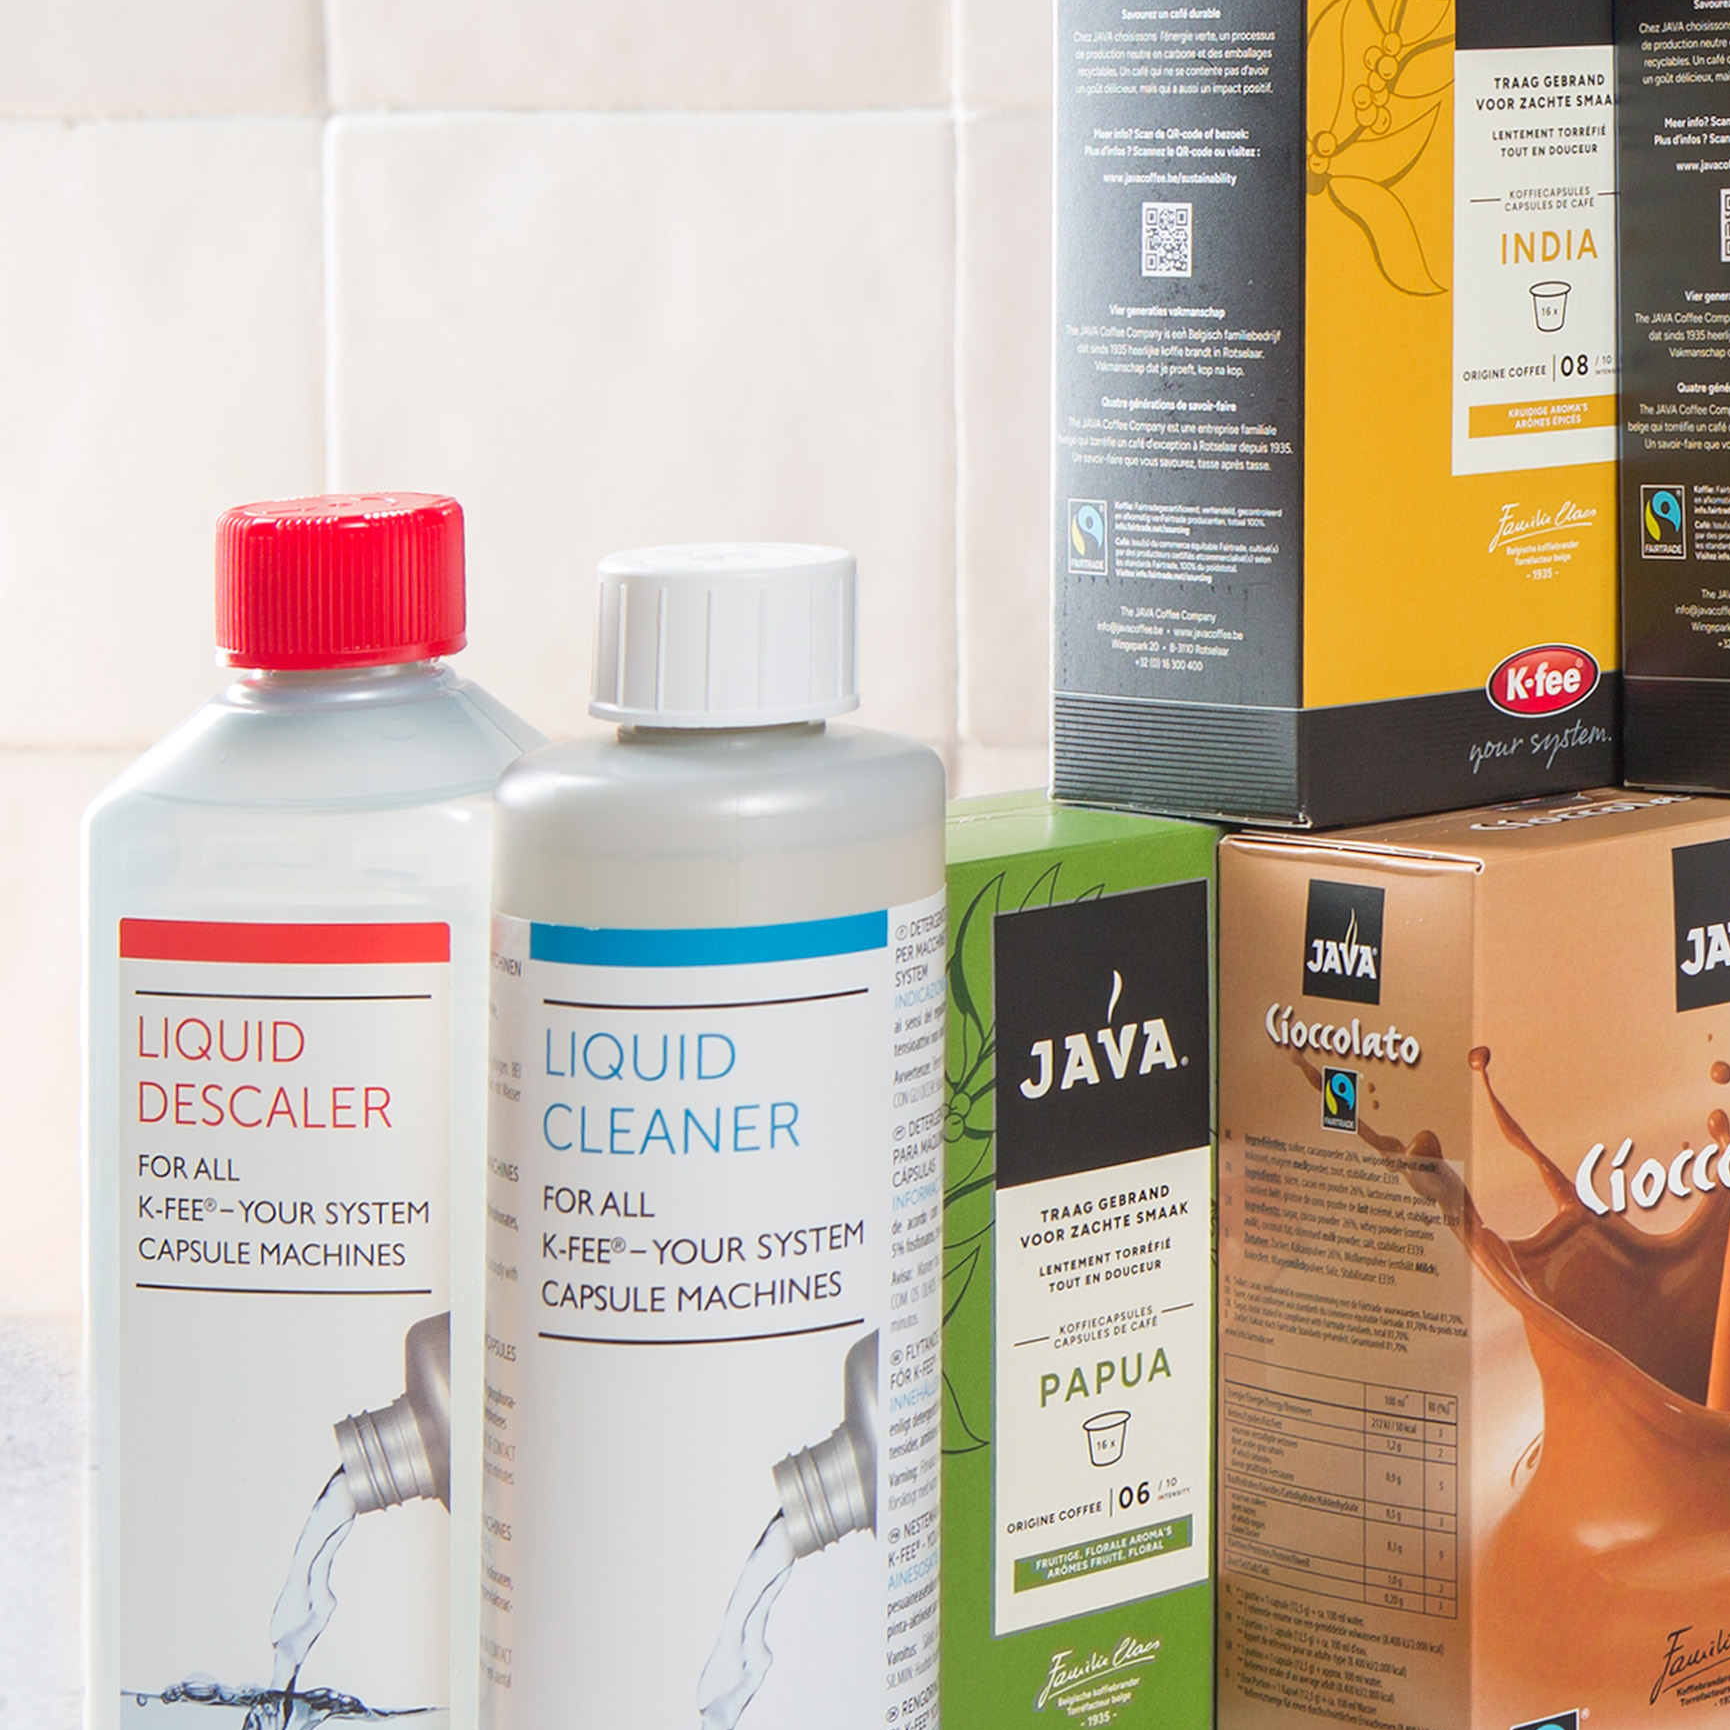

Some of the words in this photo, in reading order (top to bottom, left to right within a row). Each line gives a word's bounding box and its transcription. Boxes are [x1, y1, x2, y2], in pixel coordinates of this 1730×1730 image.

[1502, 229, 1597, 264] INDIA
[1463, 368, 1502, 381] ORIGINE
[1509, 365, 1546, 377] COFFEE
[1561, 354, 1588, 377] 08
[1469, 738, 1523, 774] your
[1307, 940, 1378, 979] JAVA
[139, 1016, 304, 1062] LIQUID
[546, 1028, 735, 1081] LIQUID
[1266, 1003, 1421, 1068] Cioccolato
[1019, 1018, 1178, 1099] JAVA
[139, 1081, 391, 1128] DESCALER
[543, 1102, 799, 1154] CLEANER
[139, 1155, 187, 1179] FOR
[194, 1158, 240, 1181] ALL
[239, 1201, 315, 1224] YOUR
[326, 1202, 428, 1225] SYSTEM
[544, 1185, 593, 1215] FOR
[600, 1191, 654, 1217] ALL
[1041, 1201, 1093, 1222] TRAAG
[1099, 1185, 1169, 1210] GEBRAND
[653, 1237, 745, 1265] YOUR
[758, 1220, 863, 1260] SYSTEM
[1020, 1229, 1064, 1248] VOOR
[1071, 1214, 1130, 1238] ZACHTE
[1137, 1201, 1188, 1224] SMAAK
[139, 1237, 250, 1264] CAPSULE
[261, 1243, 405, 1266] MACHINES
[542, 1280, 665, 1312] CAPSULE
[678, 1271, 841, 1312] MACHINES
[1041, 1348, 1171, 1408] PAPUA
[1007, 1515, 1055, 1535] ORIGINE
[1059, 1501, 1101, 1521] COFFEE
[1119, 1482, 1150, 1509] 06
